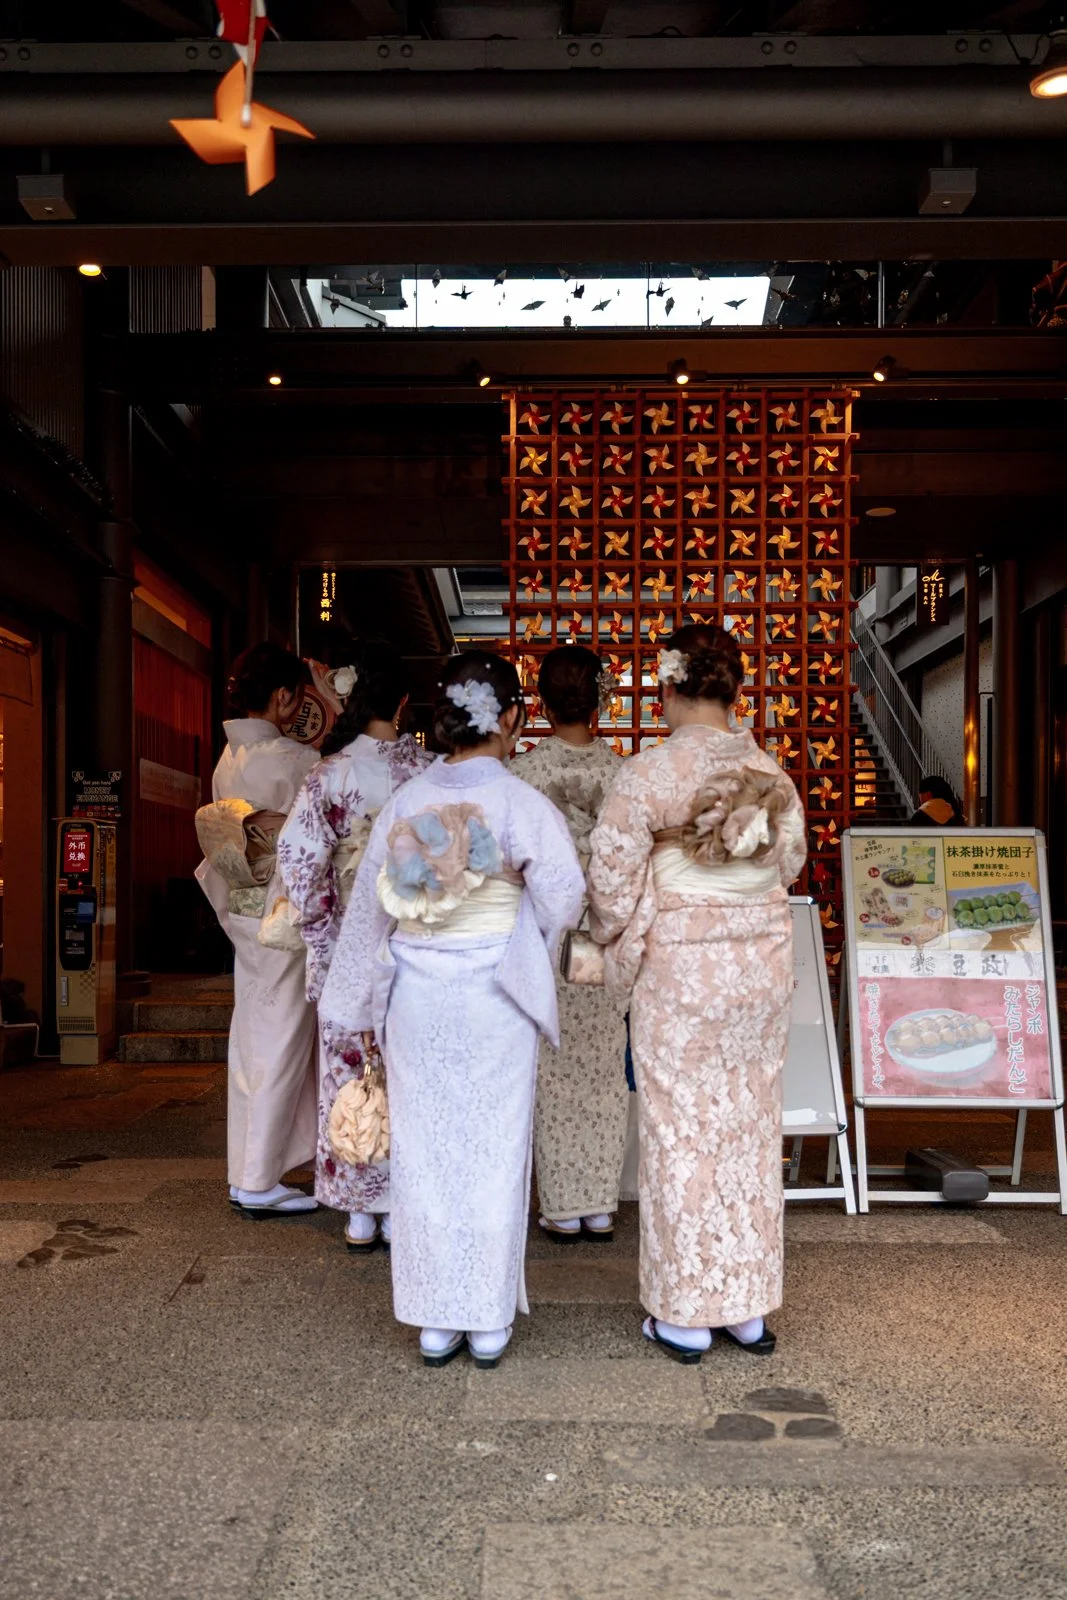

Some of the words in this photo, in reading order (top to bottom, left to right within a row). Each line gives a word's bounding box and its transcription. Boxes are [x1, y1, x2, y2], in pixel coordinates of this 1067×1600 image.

[83, 786, 112, 795] MONEY
[76, 794, 119, 803] EXCHANGE
[947, 845, 1034, 858] 抹茶掛け焼団子
[1025, 984, 1043, 1034] ジャンボ
[1003, 985, 1027, 1093] みたらしだんご
